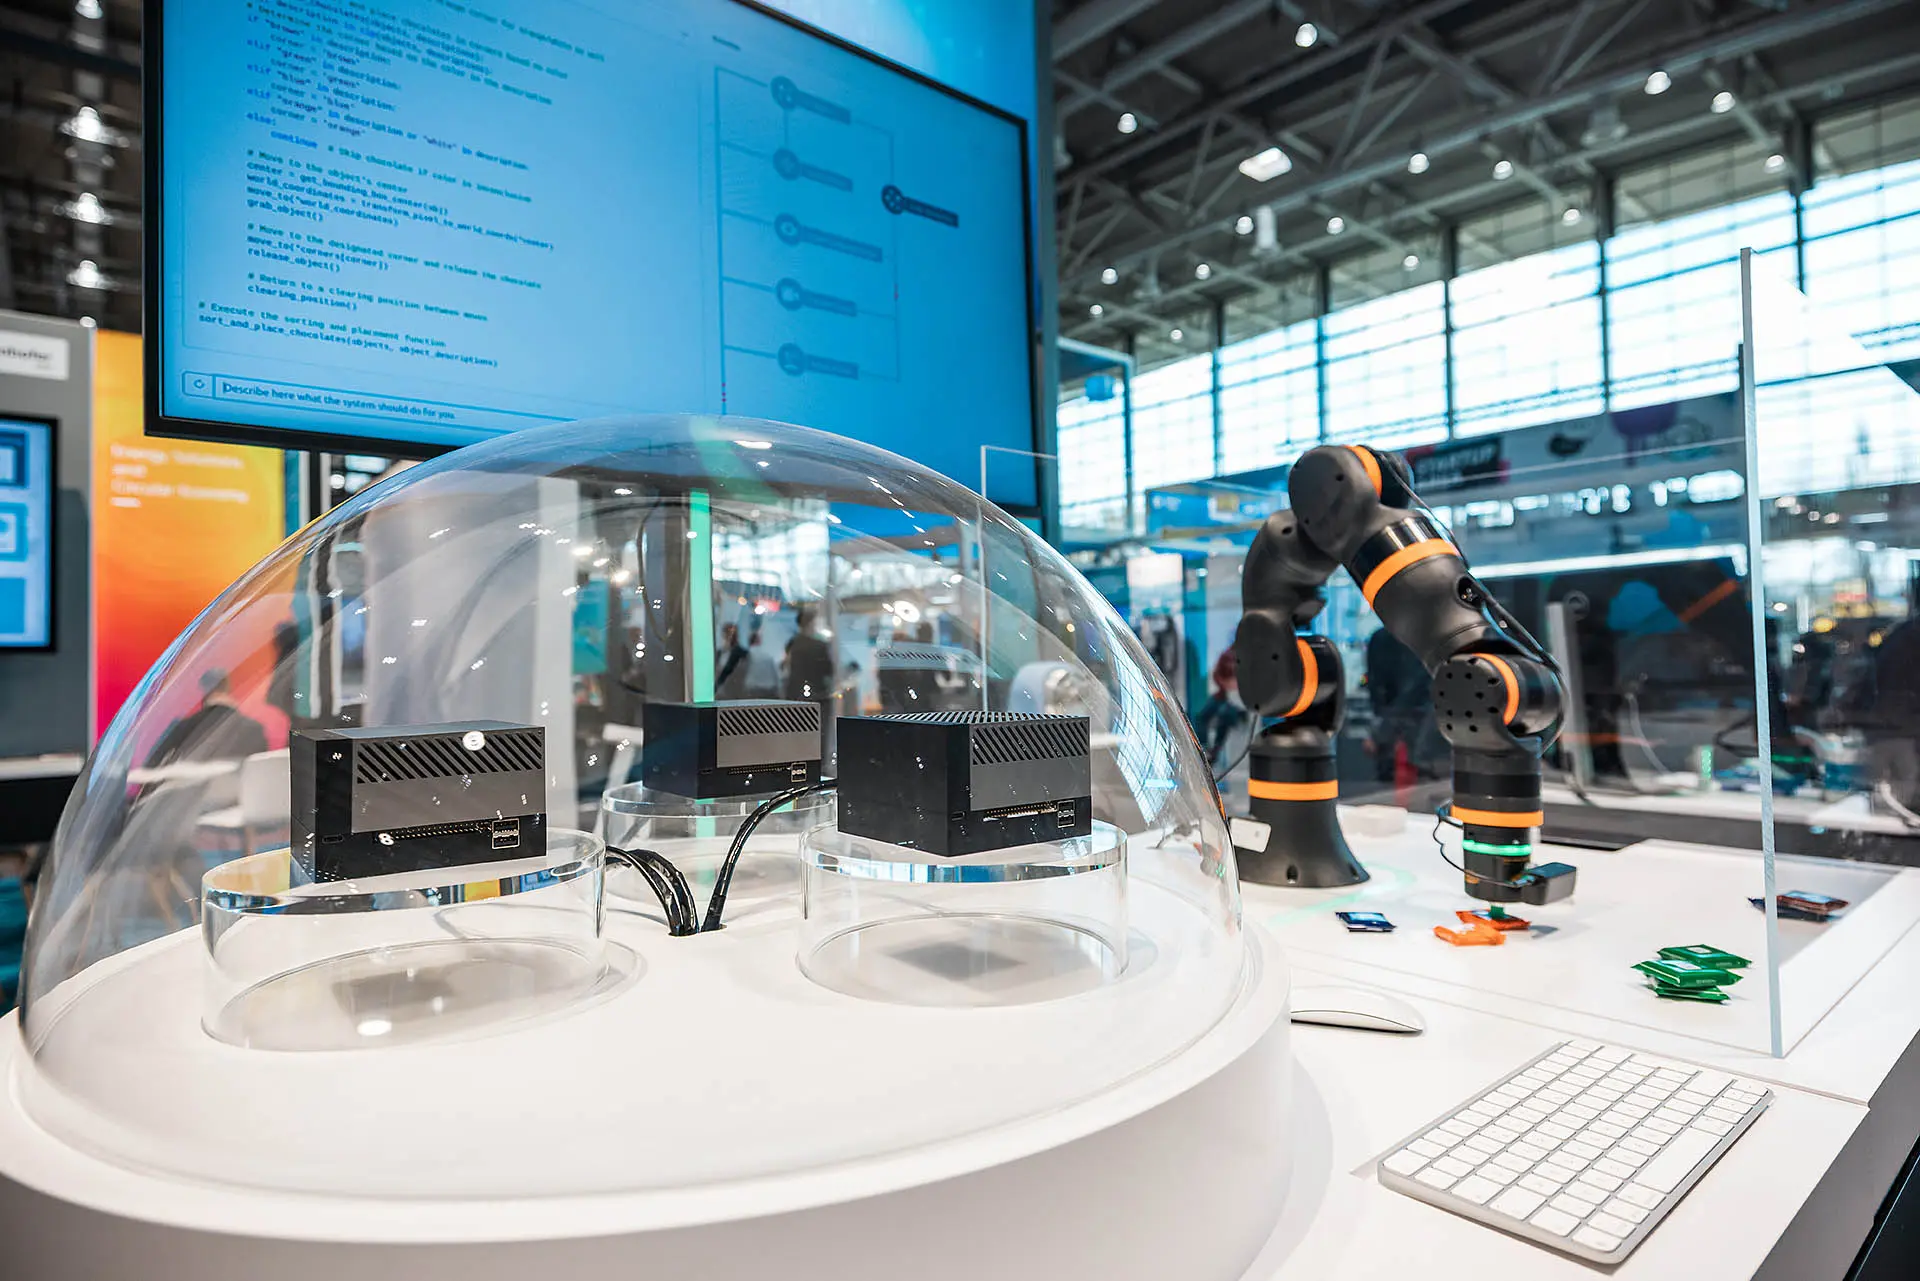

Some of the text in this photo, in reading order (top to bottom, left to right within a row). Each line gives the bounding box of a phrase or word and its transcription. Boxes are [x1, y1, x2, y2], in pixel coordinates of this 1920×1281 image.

[211, 302, 254, 316] Execute
[260, 310, 278, 320] the
[284, 315, 324, 330] sorting
[329, 323, 346, 331] and
[351, 326, 399, 340] placement
[404, 334, 445, 347] function
[223, 382, 269, 397] Describe
[272, 388, 295, 400] here
[297, 391, 321, 403] what
[324, 394, 341, 405] the
[343, 397, 375, 410] system
[378, 402, 408, 414] should
[410, 405, 422, 416] do
[423, 407, 436, 417] for
